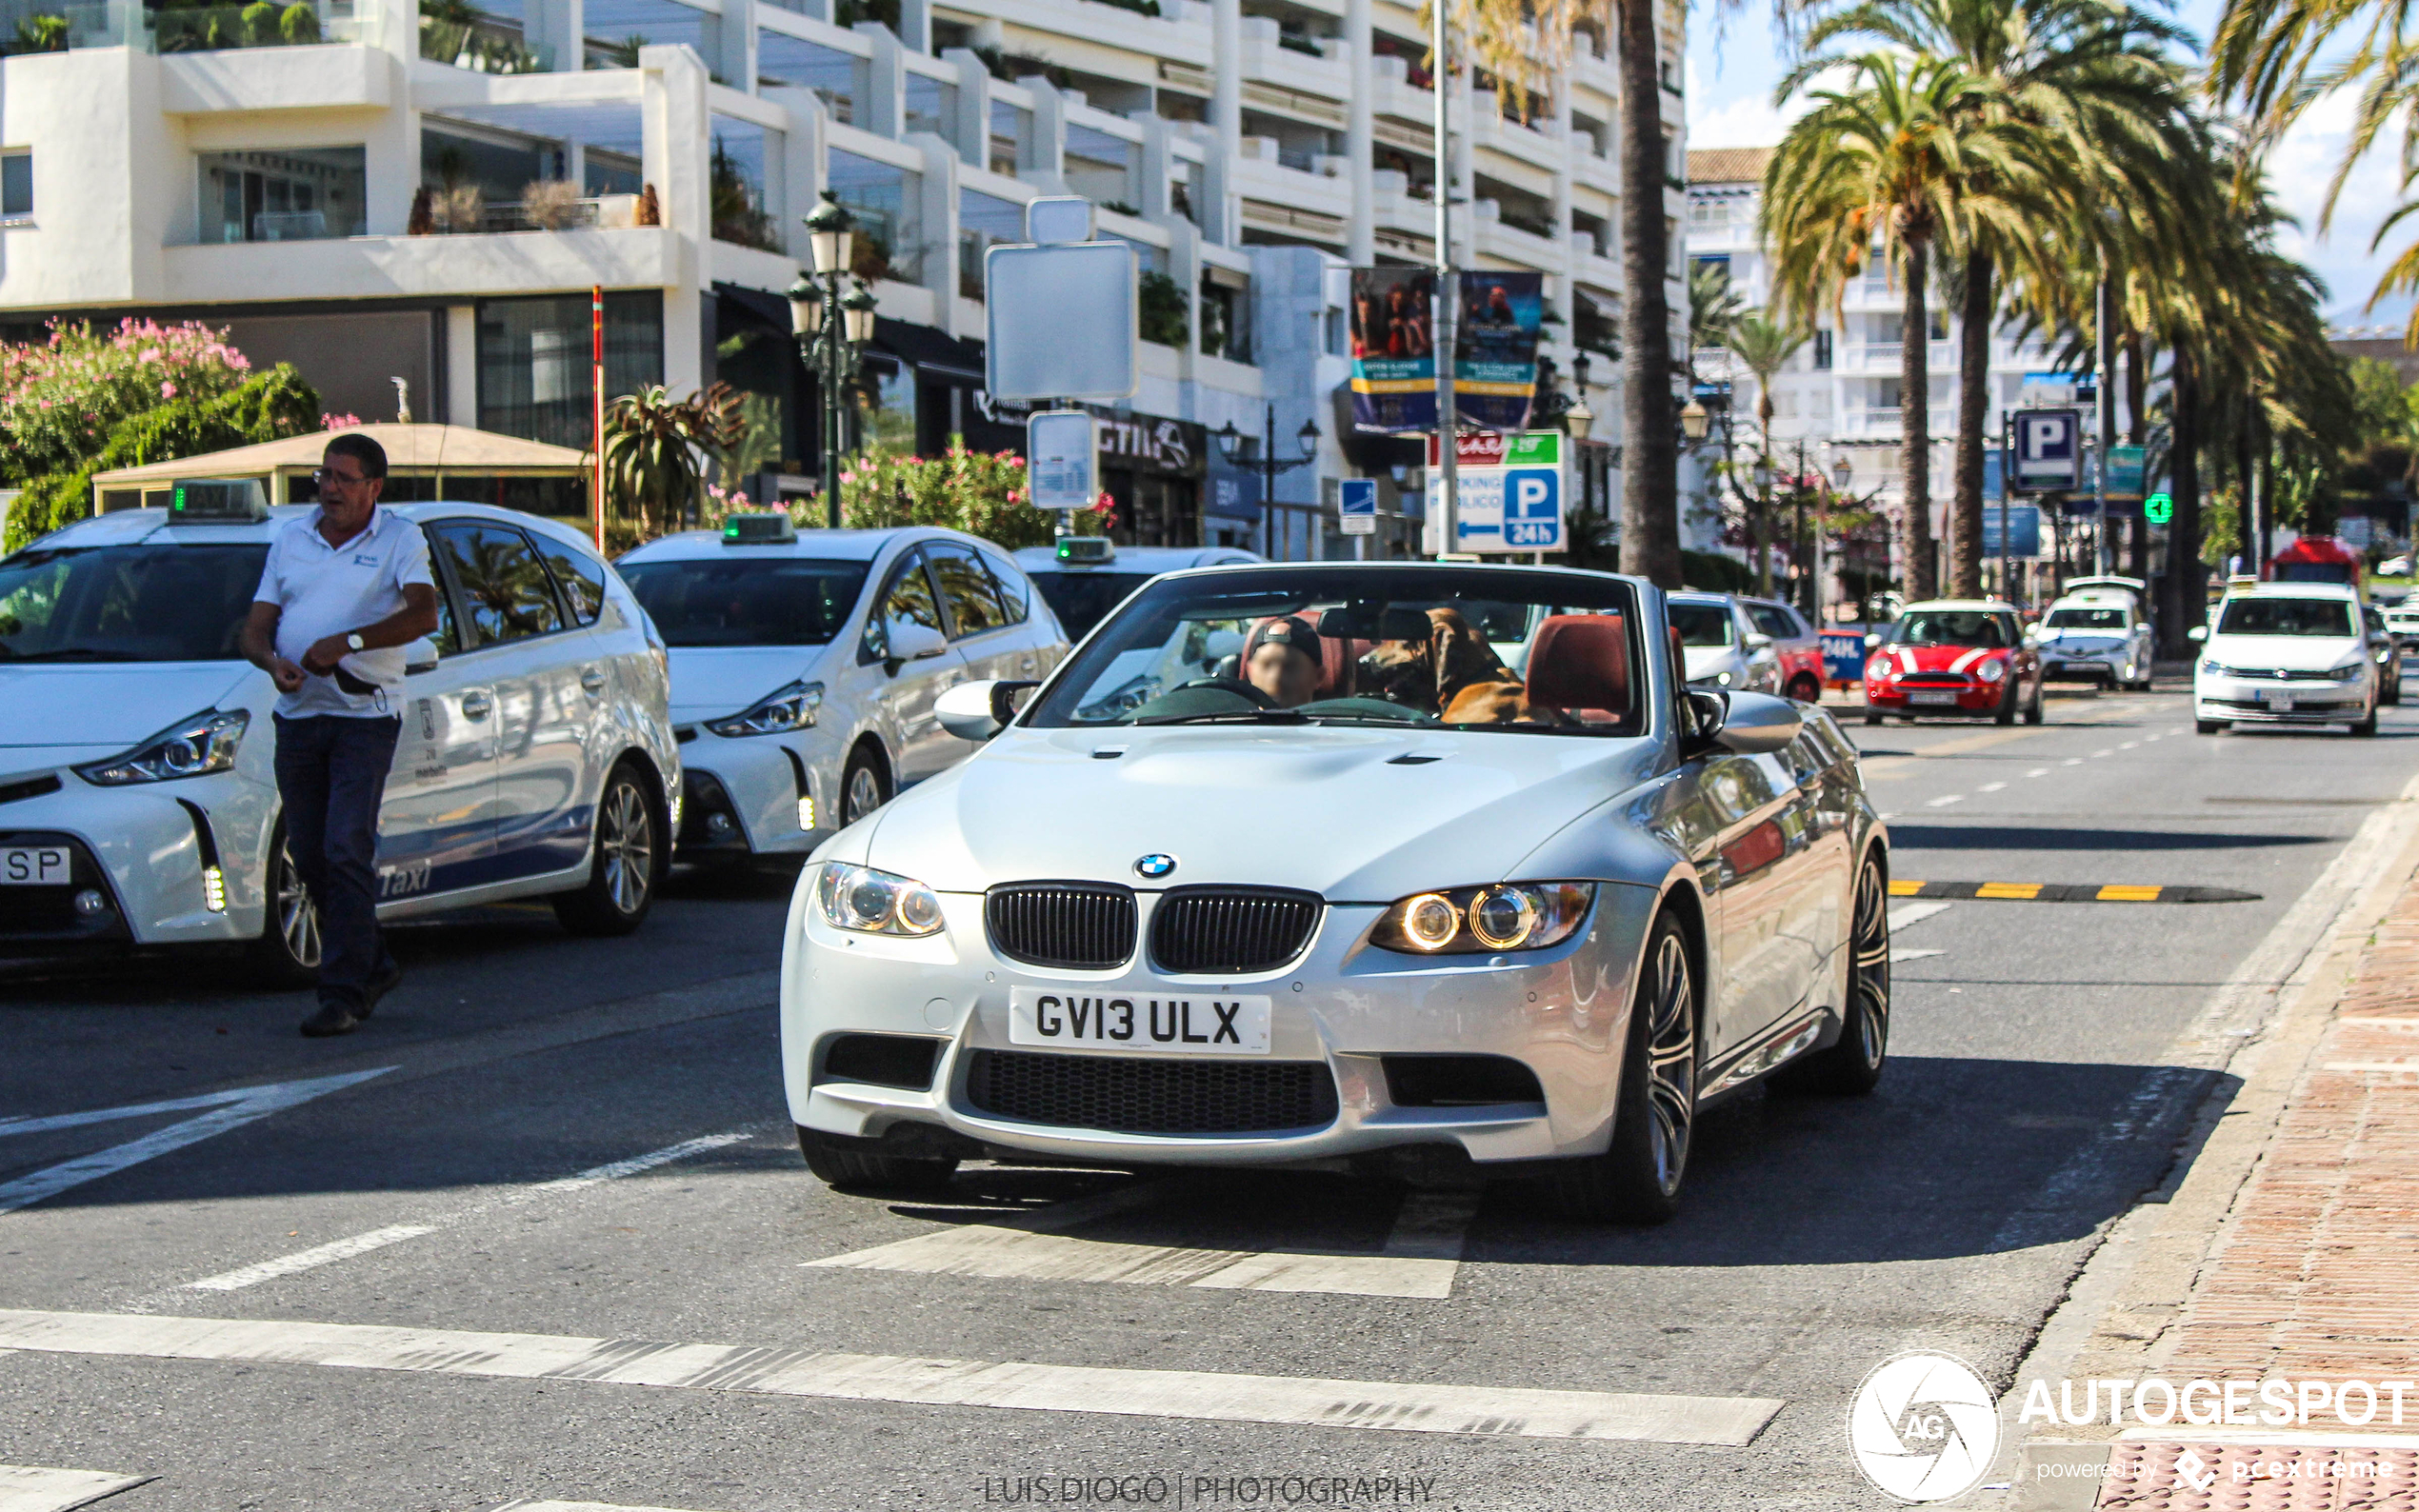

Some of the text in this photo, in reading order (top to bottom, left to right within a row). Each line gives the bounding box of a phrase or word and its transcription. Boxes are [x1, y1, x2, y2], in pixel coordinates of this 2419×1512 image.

[2029, 420, 2065, 459] P
[1429, 477, 1503, 490] PKING
[1429, 495, 1503, 508] PLICO
[1518, 478, 1548, 517] P
[1512, 525, 1552, 544] 24h
[378, 858, 431, 897] Taxi
[1036, 996, 1241, 1044] GV13 ULX
